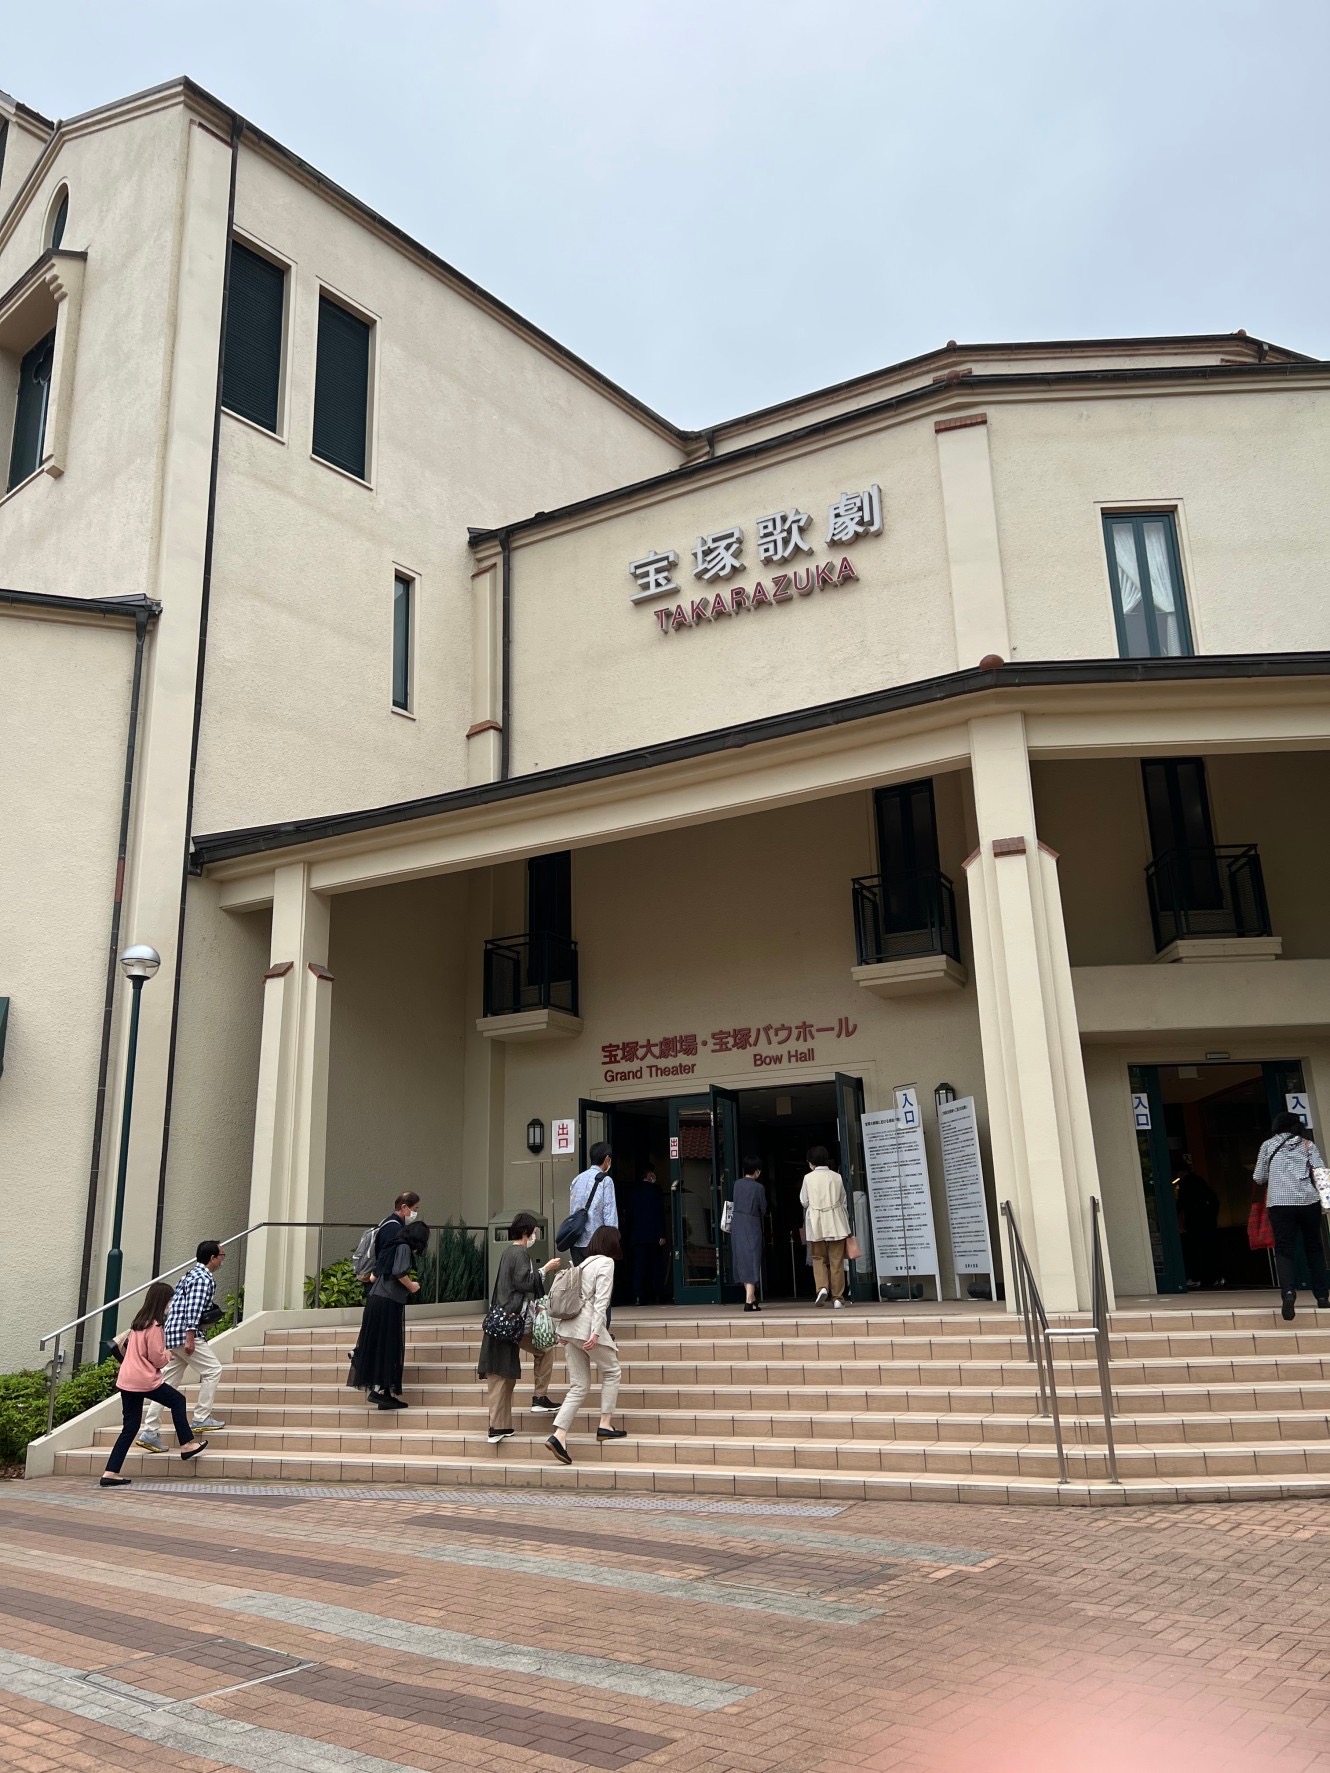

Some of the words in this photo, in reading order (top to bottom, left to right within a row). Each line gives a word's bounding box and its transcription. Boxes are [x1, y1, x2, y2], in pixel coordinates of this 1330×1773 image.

[628, 484, 885, 605] 宝塚歌劇
[654, 556, 858, 632] TAKARAZUKA
[753, 1052, 783, 1067] Bow
[787, 1048, 815, 1063] Hall
[604, 1065, 643, 1083] Grand
[646, 1062, 697, 1079] Theater
[902, 1093, 915, 1124] 入口
[1134, 1096, 1150, 1126] 入口
[557, 1123, 569, 1149] 出口
[670, 1138, 678, 1157] 出口
